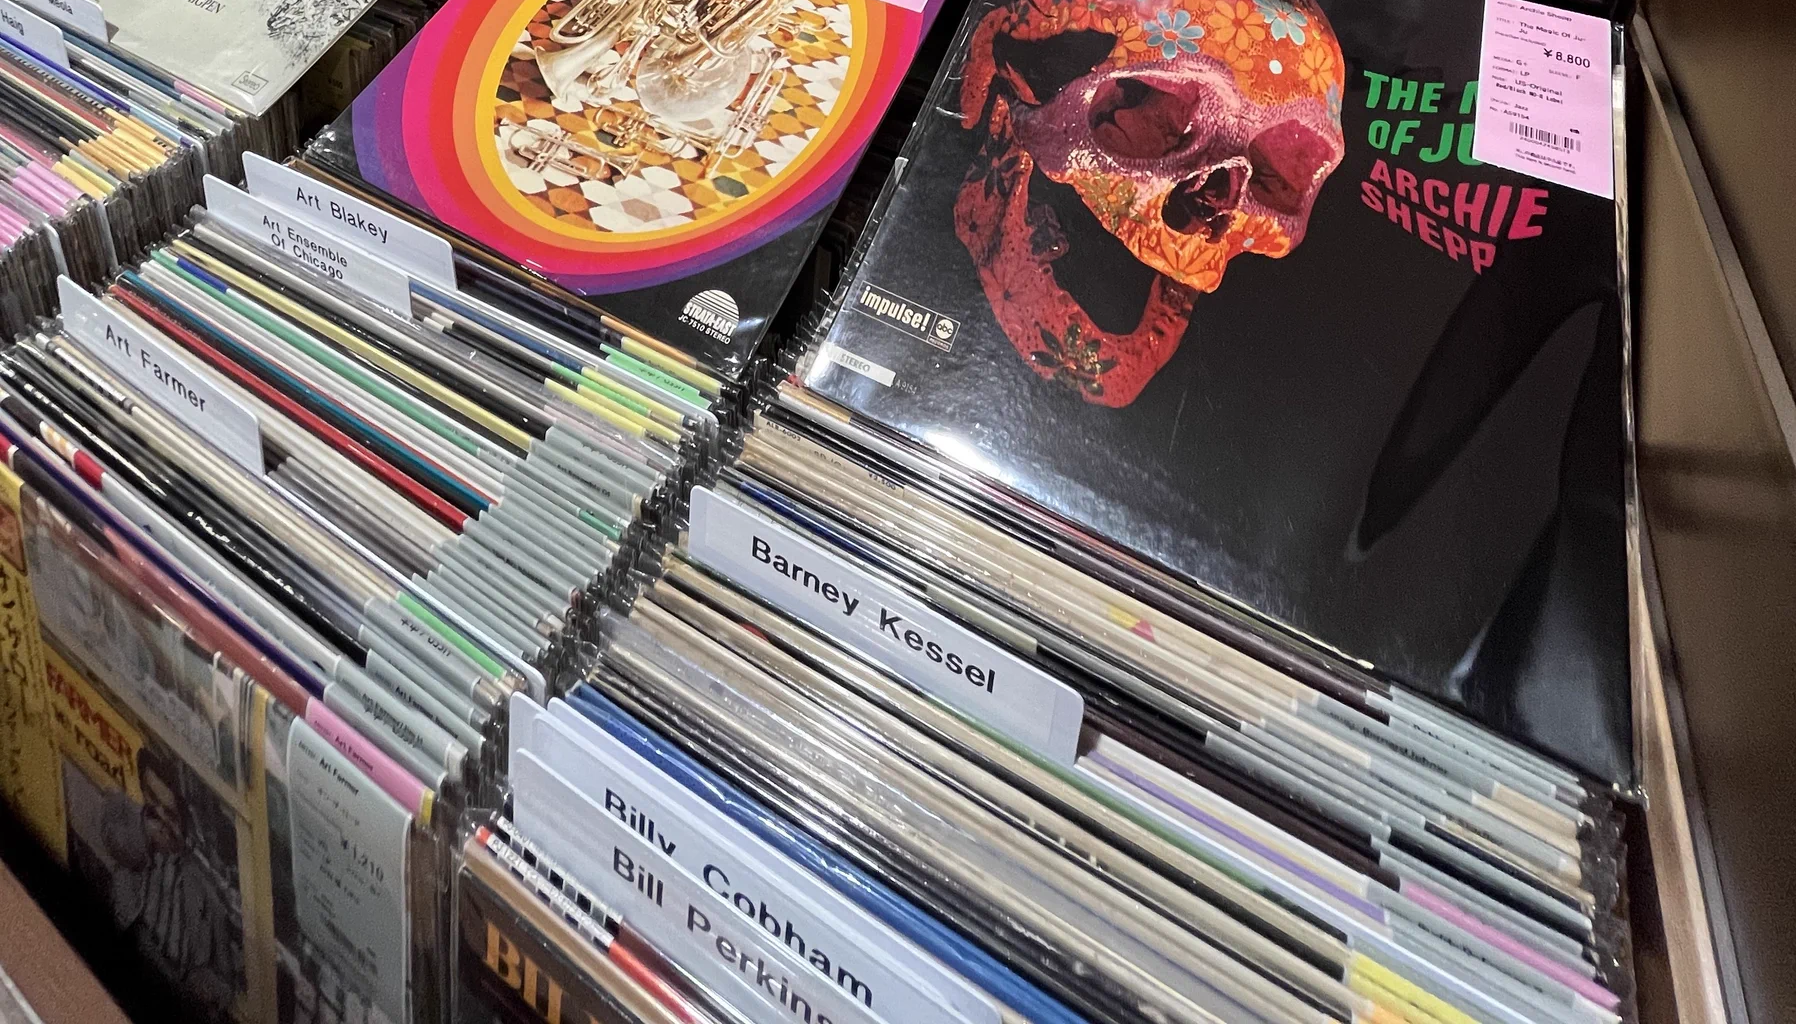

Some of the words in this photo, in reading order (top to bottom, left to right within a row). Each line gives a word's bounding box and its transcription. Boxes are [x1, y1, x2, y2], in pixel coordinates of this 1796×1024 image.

[0, 9, 24, 36] Haig
[1519, 22, 1534, 30] The
[1536, 26, 1559, 36] Magic
[1543, 48, 1591, 68] ¥8,800
[1363, 70, 1444, 114] THE
[1367, 120, 1421, 155] OF
[296, 186, 321, 211] Art
[330, 201, 388, 244] Blakey
[1369, 158, 1549, 240] ARCHIE
[263, 215, 281, 233] Art
[288, 228, 347, 267] Ensemble
[1360, 181, 1496, 275] SHEPP
[271, 234, 285, 250] Of
[293, 245, 343, 280] Chicago
[683, 301, 737, 337] STRATA-EAST
[860, 286, 931, 332] impulse!
[936, 321, 952, 334] abc
[705, 328, 731, 344] STEREO
[106, 324, 131, 357] Art
[141, 349, 206, 412] Farmer
[840, 354, 871, 372] STEREO
[751, 535, 860, 616] Barney
[879, 607, 996, 693] Kessel
[605, 787, 677, 857] Billy
[703, 863, 873, 1007] Cobham
[613, 845, 664, 907] Bill
